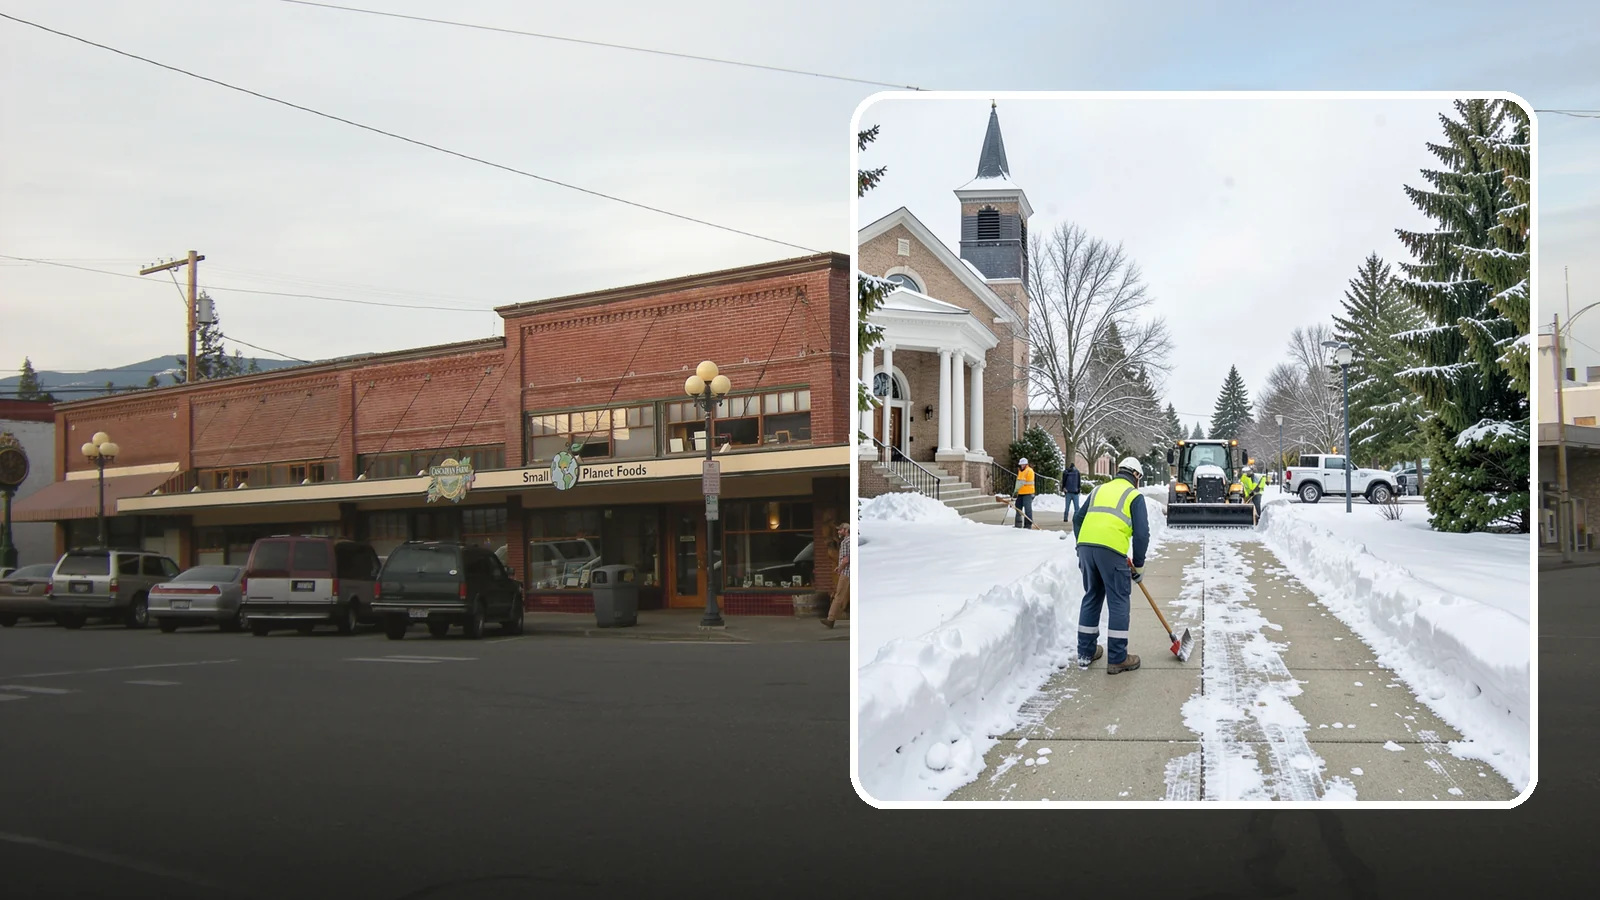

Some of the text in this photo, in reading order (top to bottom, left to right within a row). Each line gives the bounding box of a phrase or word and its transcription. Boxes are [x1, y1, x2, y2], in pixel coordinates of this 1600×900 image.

[523, 464, 647, 483] Small Planet Foods
